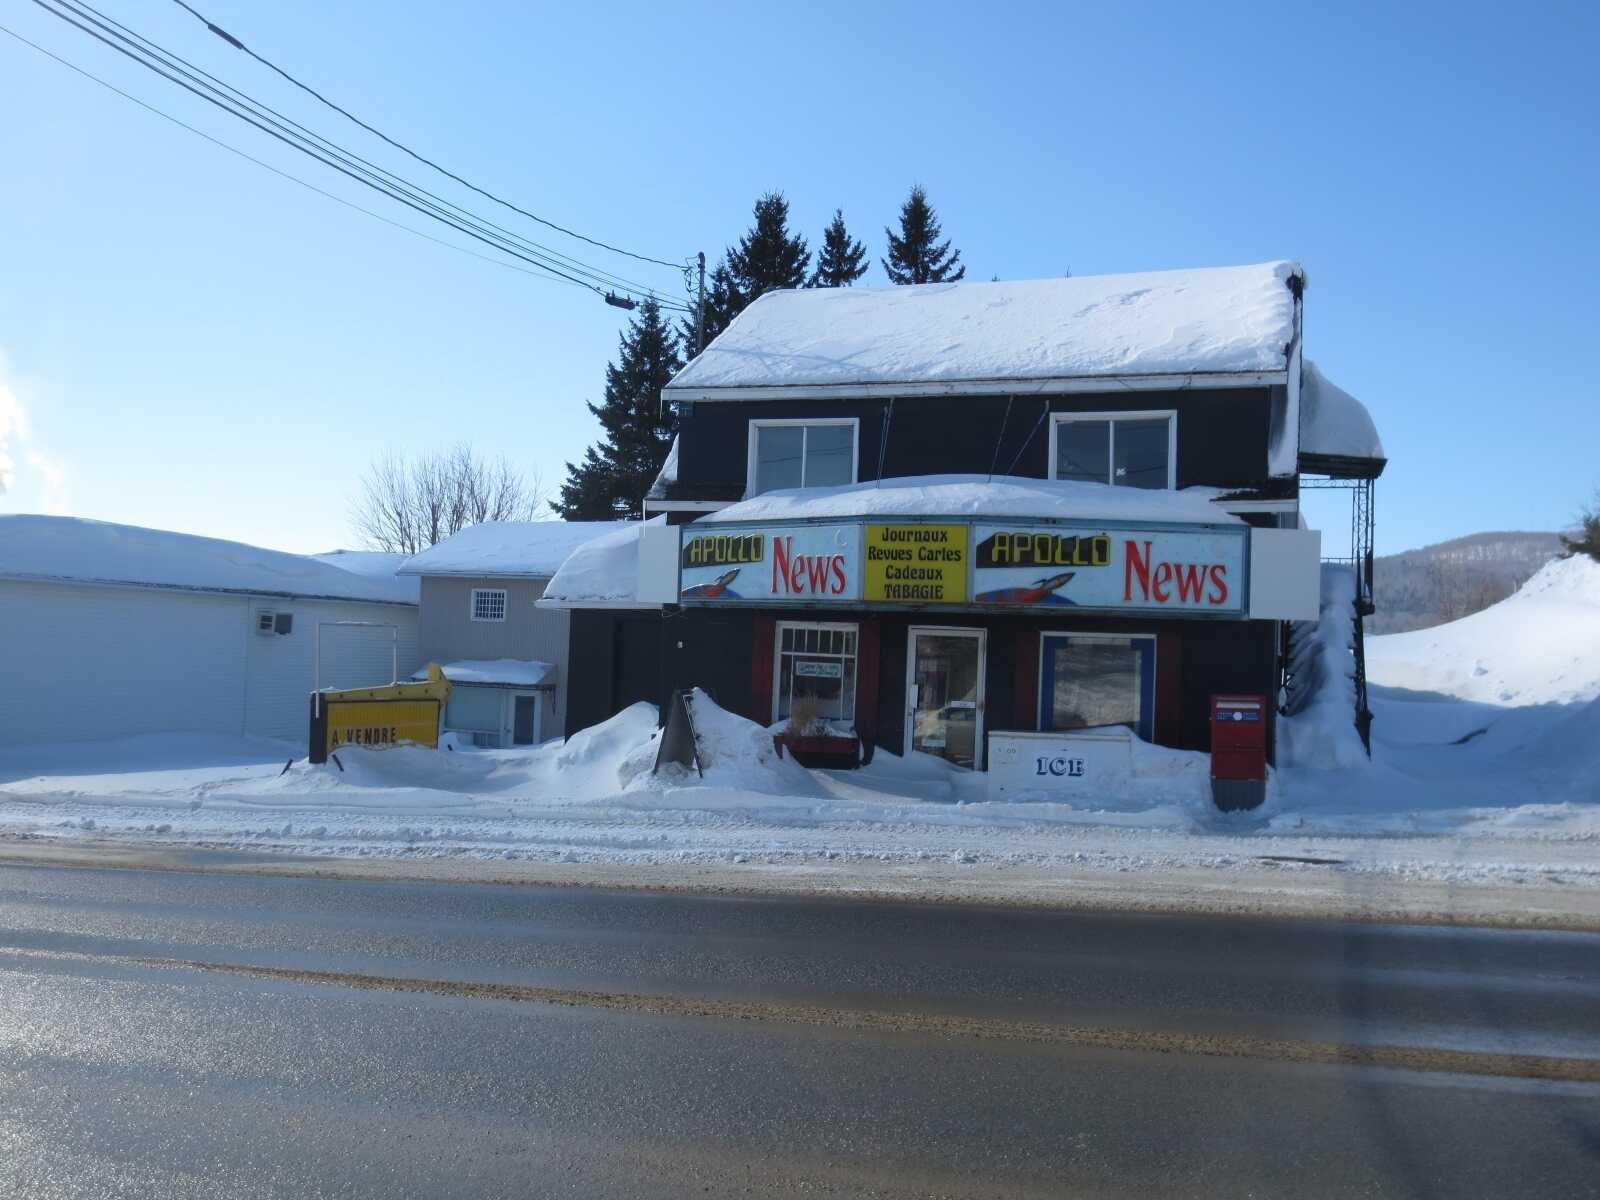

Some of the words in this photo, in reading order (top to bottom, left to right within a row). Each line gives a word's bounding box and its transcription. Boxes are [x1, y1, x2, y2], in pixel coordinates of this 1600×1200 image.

[881, 527, 948, 543] Journaux
[867, 546, 913, 561] Revues
[918, 547, 962, 562] Cartes
[690, 534, 763, 563] APOLLO
[770, 536, 846, 595] News
[885, 565, 943, 581] Cadeaux
[991, 531, 1112, 566] APOLLO
[1123, 540, 1229, 605] News
[884, 583, 944, 600] TABAGIE
[346, 727, 397, 745] VENDRE
[1036, 756, 1085, 777] ICE
